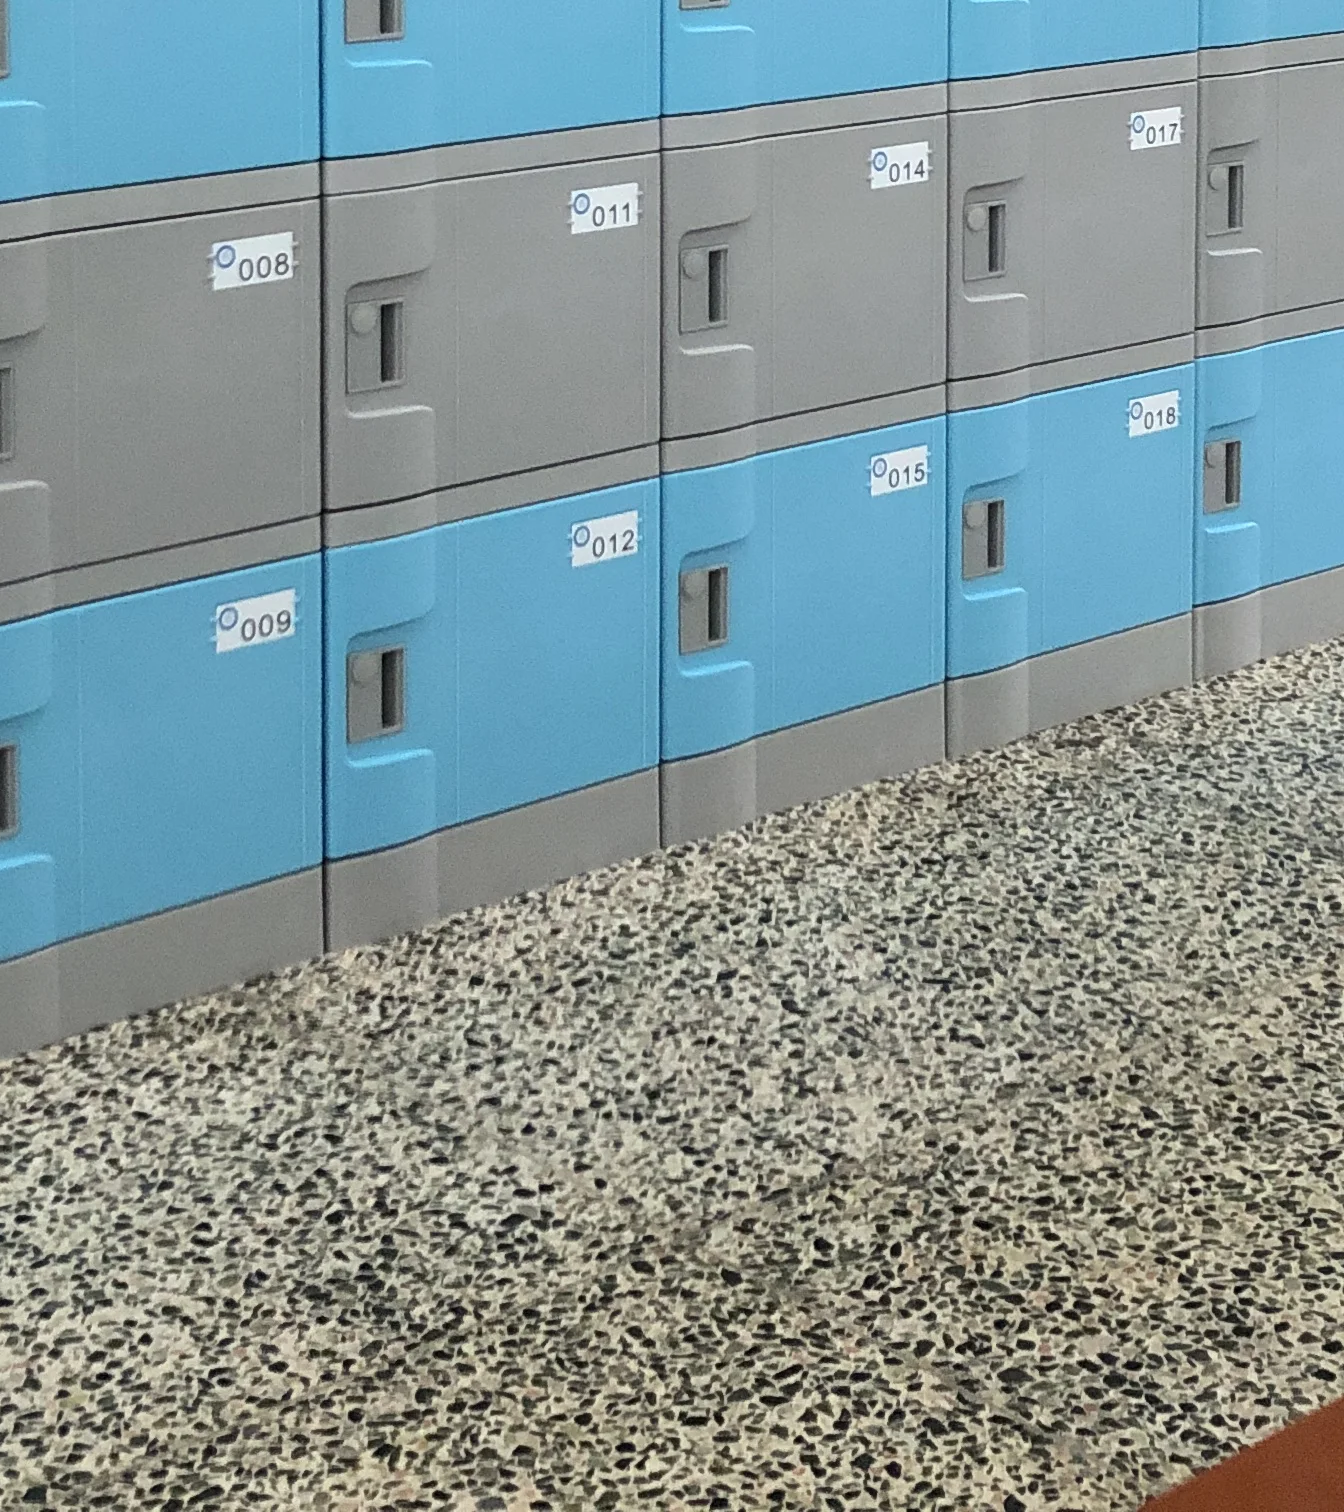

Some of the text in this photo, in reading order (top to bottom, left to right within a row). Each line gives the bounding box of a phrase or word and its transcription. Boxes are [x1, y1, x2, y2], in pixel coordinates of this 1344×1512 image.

[1145, 122, 1180, 146] 017
[886, 160, 928, 186] 014
[591, 201, 634, 230] 011
[237, 251, 291, 282] 008
[1143, 405, 1179, 431] 018
[887, 460, 927, 489] 015
[591, 528, 637, 559] 012
[239, 610, 294, 644] 009
